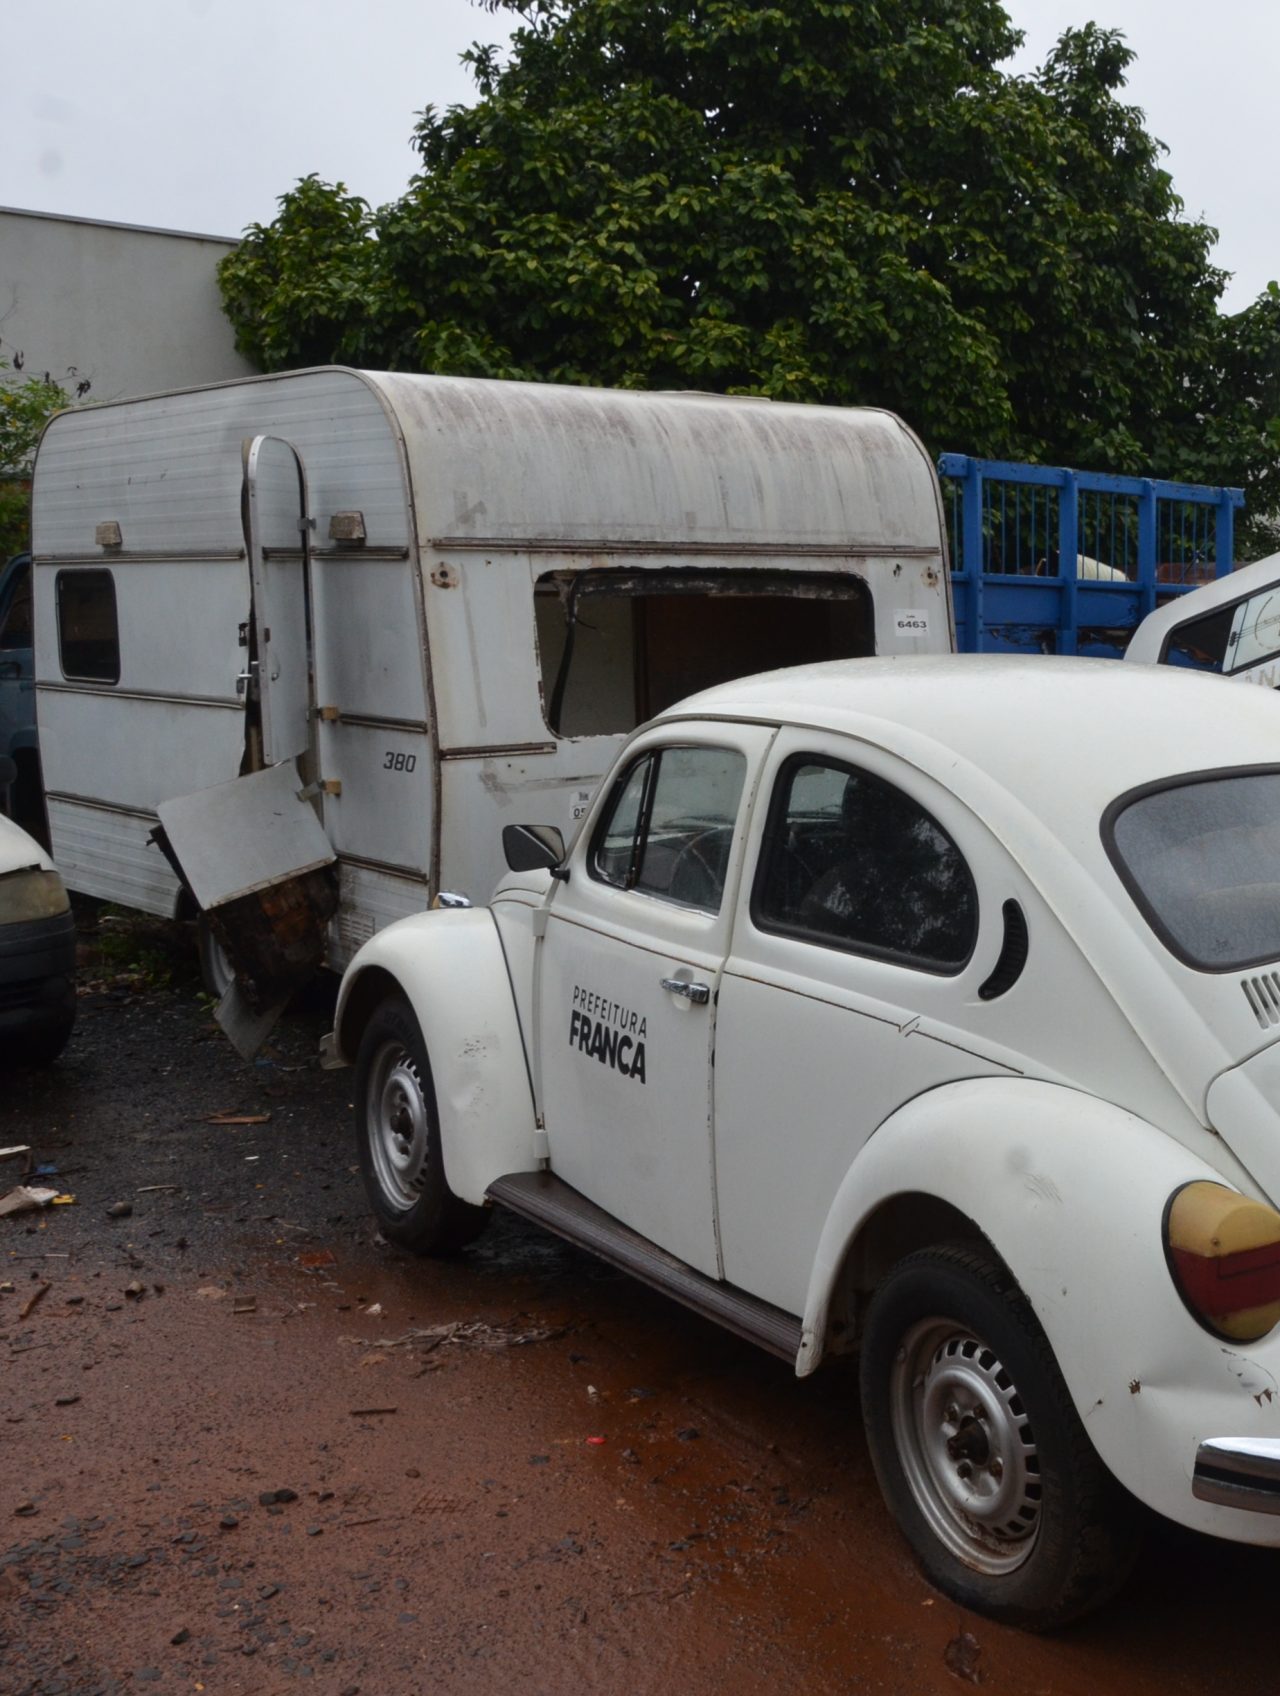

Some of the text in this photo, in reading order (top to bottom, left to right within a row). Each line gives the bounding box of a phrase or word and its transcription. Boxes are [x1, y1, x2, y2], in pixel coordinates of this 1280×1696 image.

[897, 620, 927, 629] 6463
[383, 751, 417, 773] 380
[572, 984, 647, 1039] PREFEITURA
[569, 1008, 647, 1085] FRANCA
